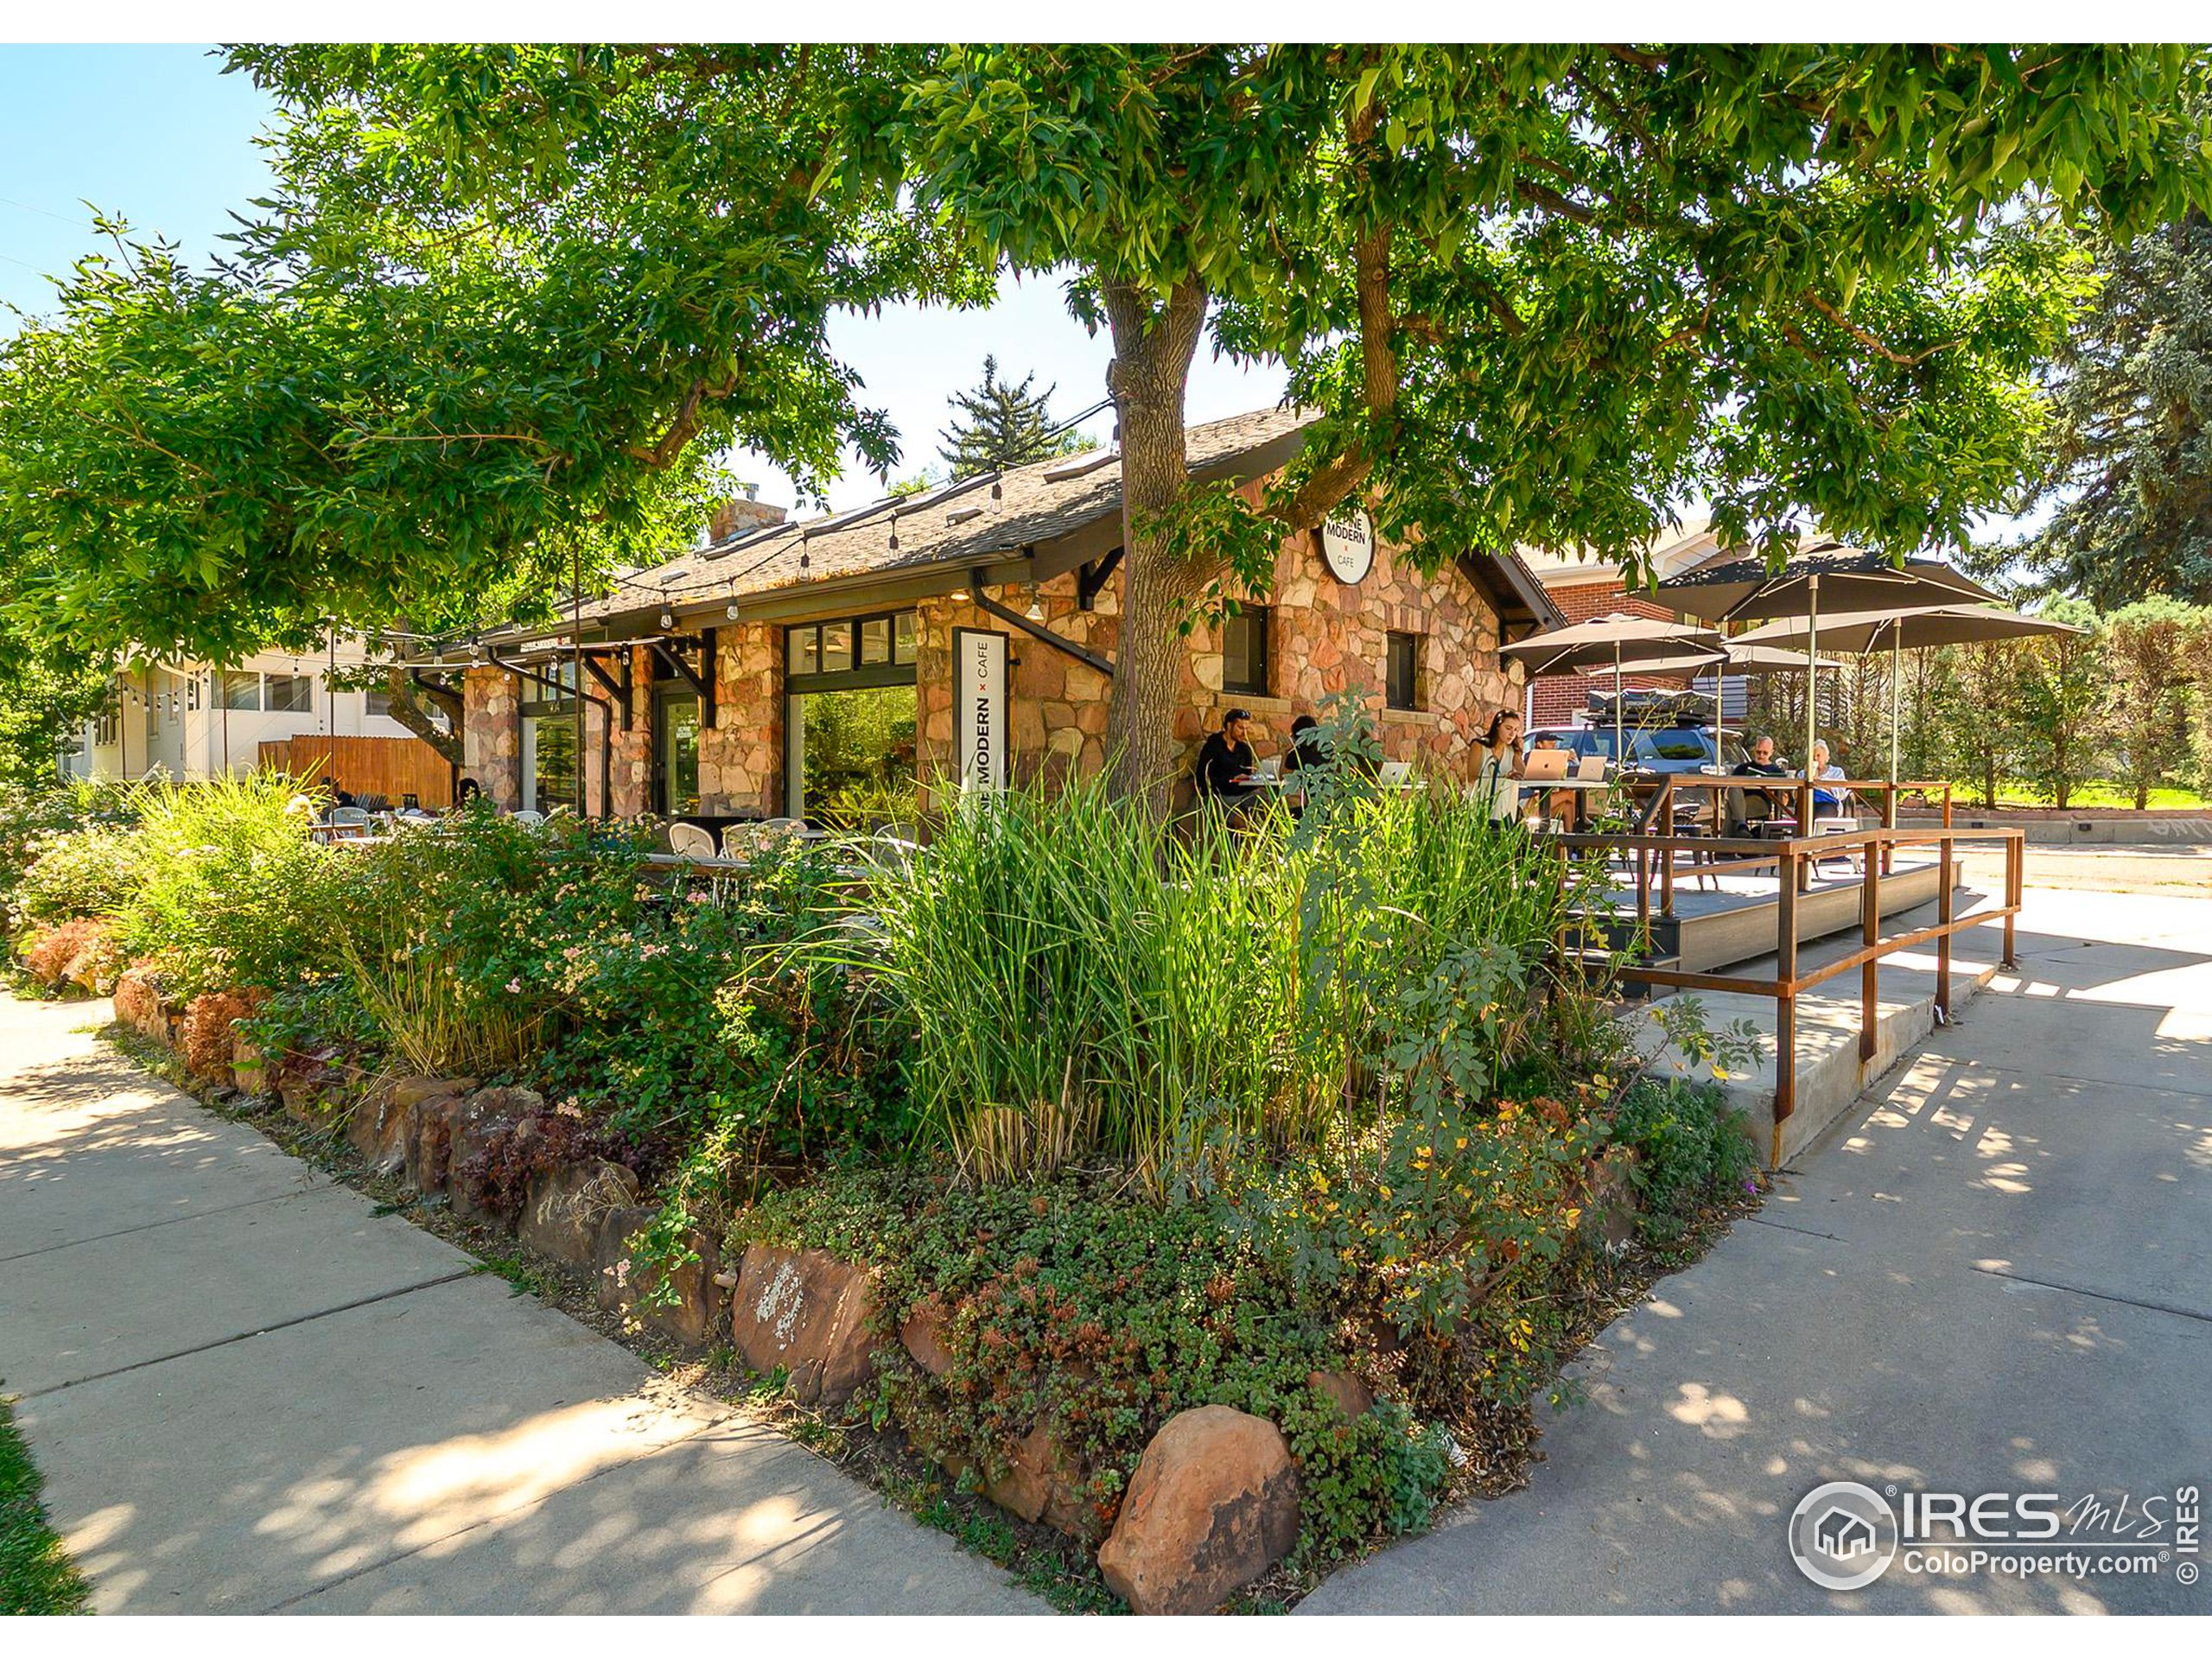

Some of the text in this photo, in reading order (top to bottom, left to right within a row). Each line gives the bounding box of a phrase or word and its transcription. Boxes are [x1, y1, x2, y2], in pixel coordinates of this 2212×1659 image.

[1326, 523, 1365, 545] MODERN
[1338, 555, 1355, 568] CAFE
[977, 642, 988, 678] CAFE
[976, 697, 989, 784] MODERN
